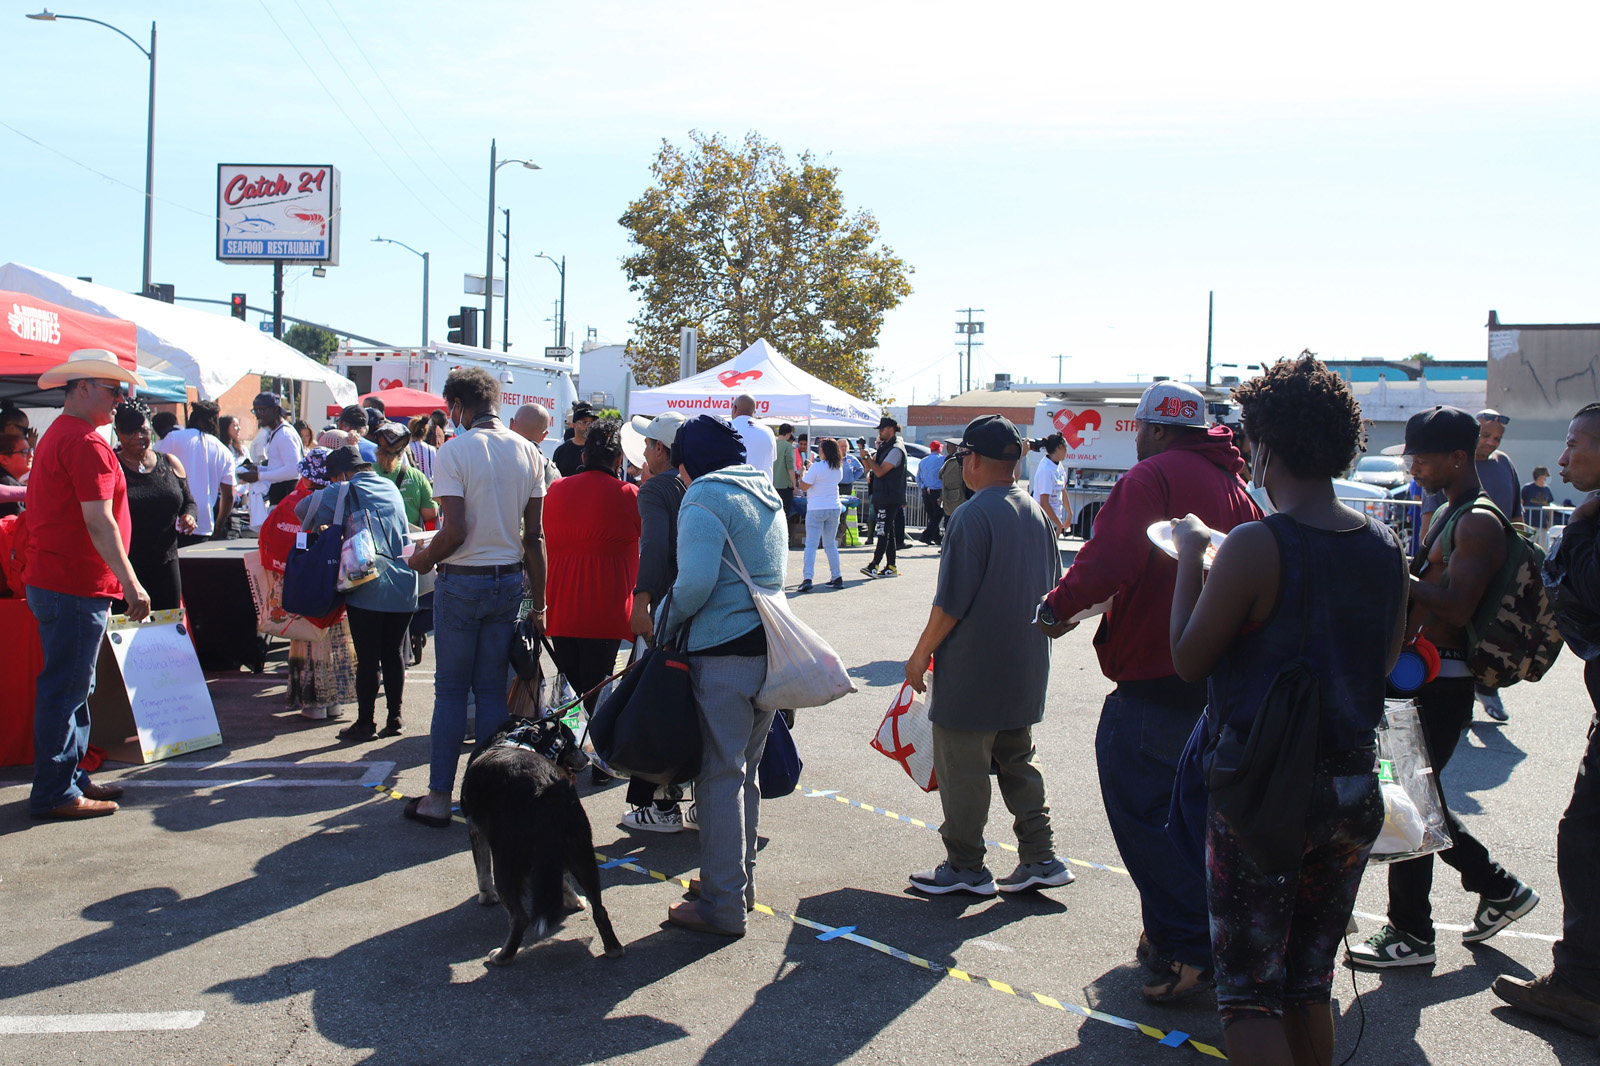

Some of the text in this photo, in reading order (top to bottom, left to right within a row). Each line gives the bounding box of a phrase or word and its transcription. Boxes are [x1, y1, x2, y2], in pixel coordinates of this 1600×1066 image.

[224, 169, 326, 206] Catch 21
[227, 240, 321, 256] SEAFOOD RESTAURANT
[22, 316, 61, 345] HEROES
[500, 391, 555, 410] TREET MEDICINE
[667, 396, 770, 413] woundwalrg
[1115, 420, 1138, 432] STR
